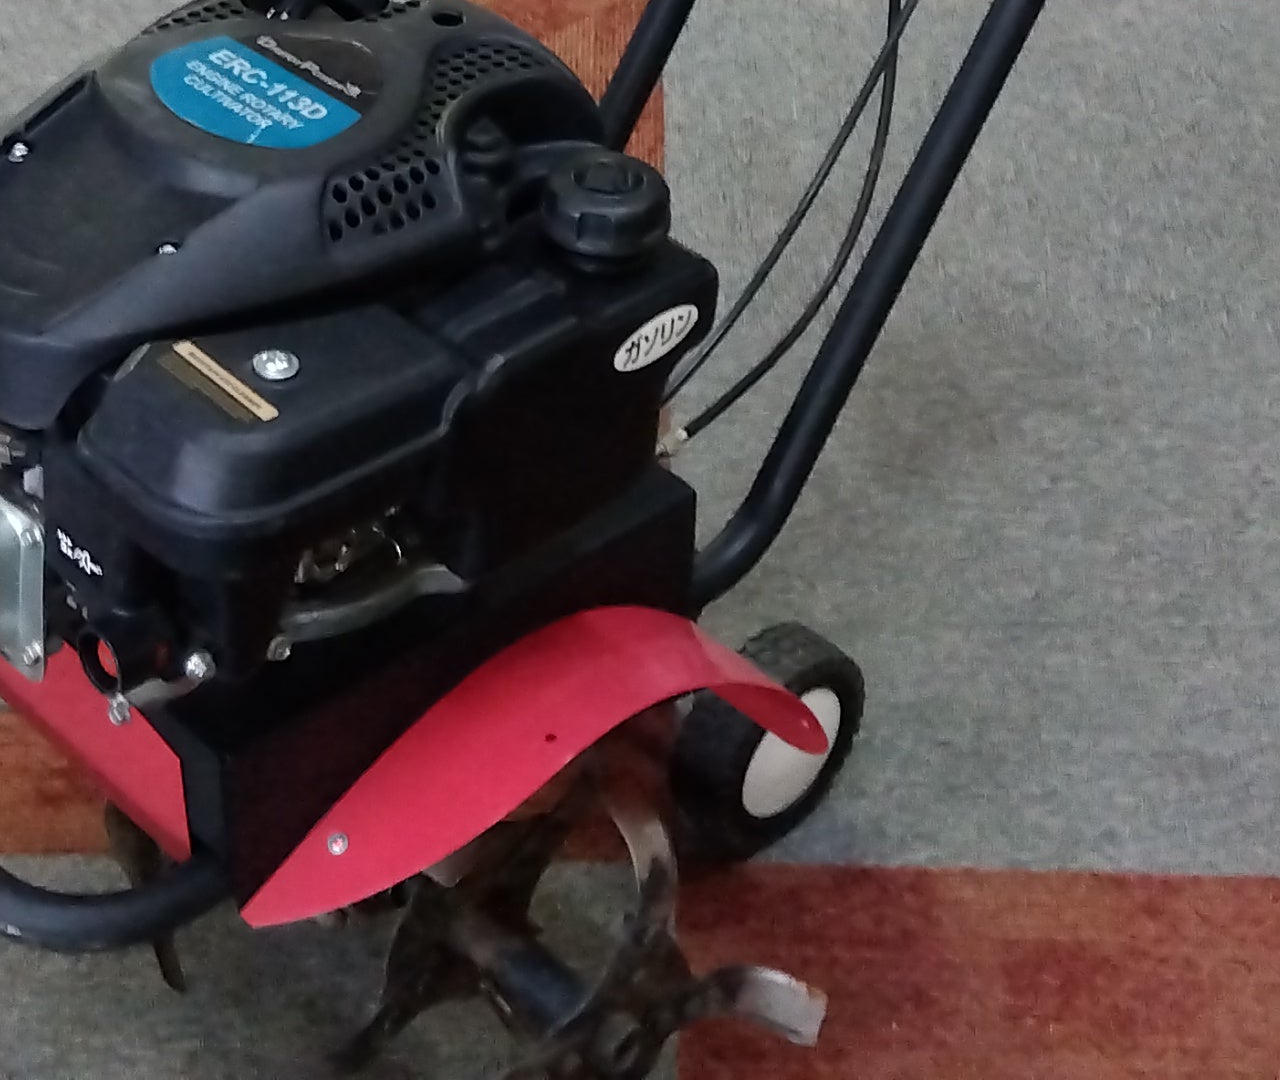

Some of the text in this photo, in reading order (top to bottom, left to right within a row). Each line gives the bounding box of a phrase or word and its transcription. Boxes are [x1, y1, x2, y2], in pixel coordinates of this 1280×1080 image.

[183, 73, 273, 129] CULTIVATOR
[185, 60, 305, 130] ENGINE ROTARY
[208, 48, 328, 120] ERC-113D
[623, 309, 692, 369] ガソリン
